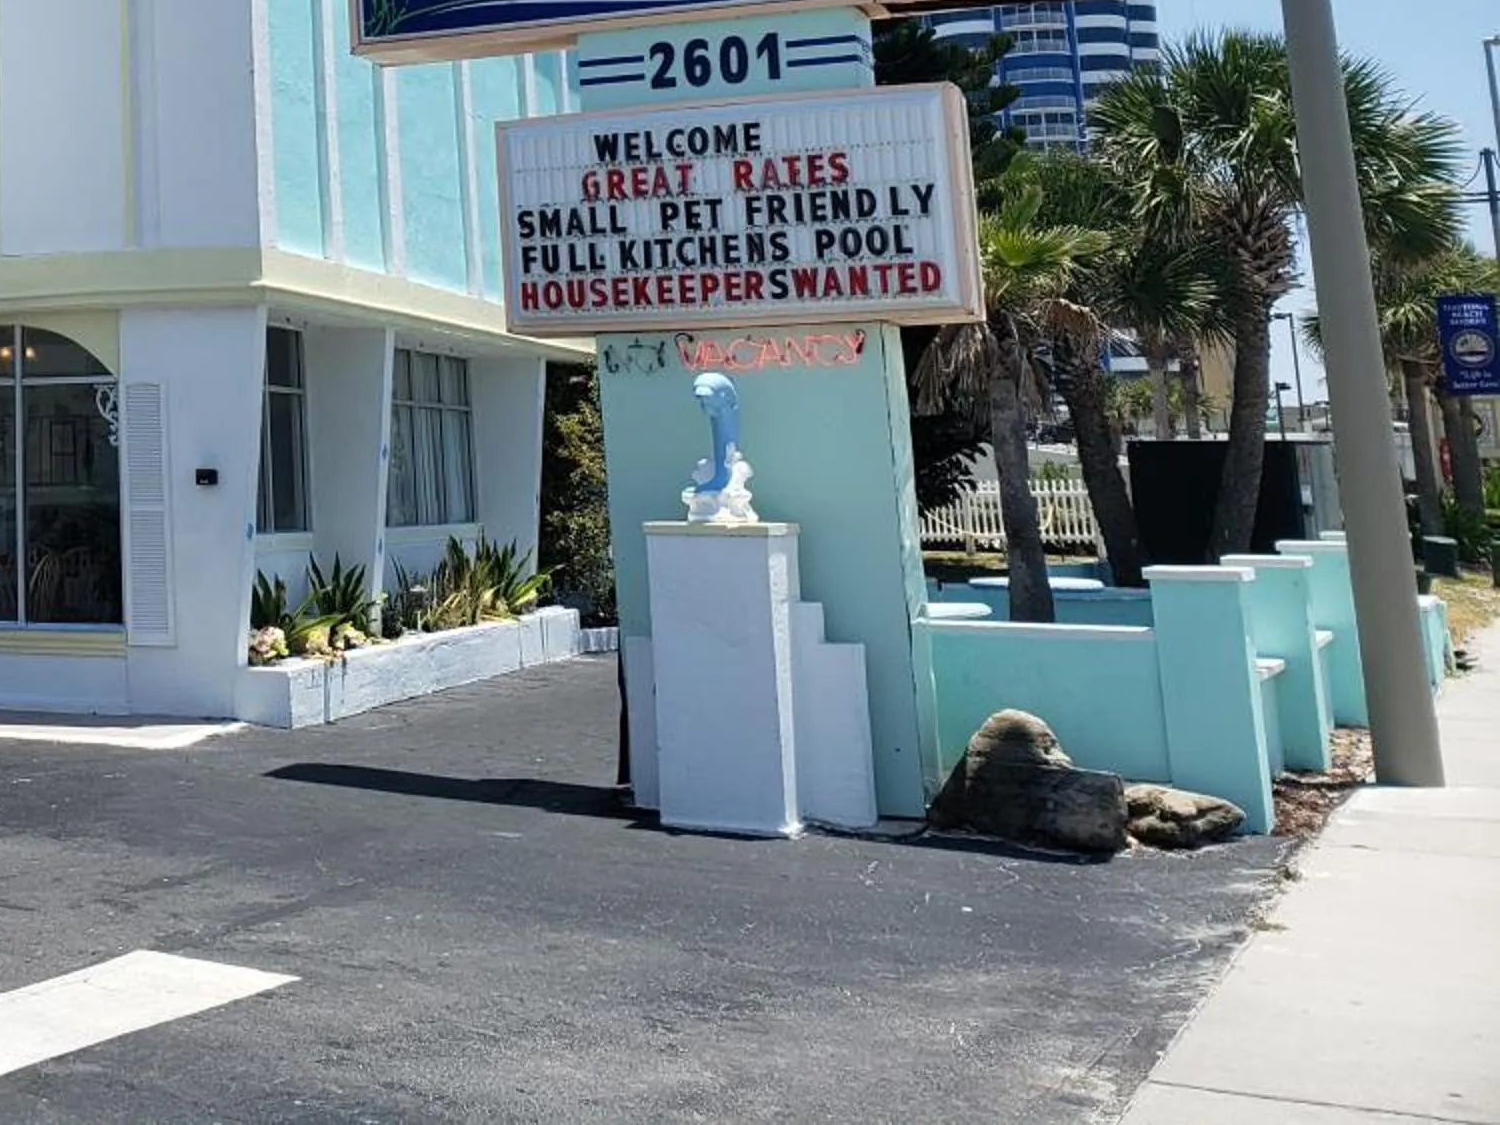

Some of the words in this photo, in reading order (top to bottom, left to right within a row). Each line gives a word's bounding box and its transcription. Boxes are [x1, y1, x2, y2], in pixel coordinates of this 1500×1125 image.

[649, 32, 781, 89] 2601
[594, 122, 762, 161] WELCOME
[581, 164, 693, 201] GREAT
[732, 152, 850, 191] RATES
[517, 204, 626, 239] SMALL
[661, 198, 722, 230] PET
[746, 183, 935, 226] FRIENDLY
[521, 243, 606, 274] FULL
[620, 231, 789, 271] KITCHENS
[815, 224, 913, 259] POOL
[675, 329, 867, 371] VACANCY
